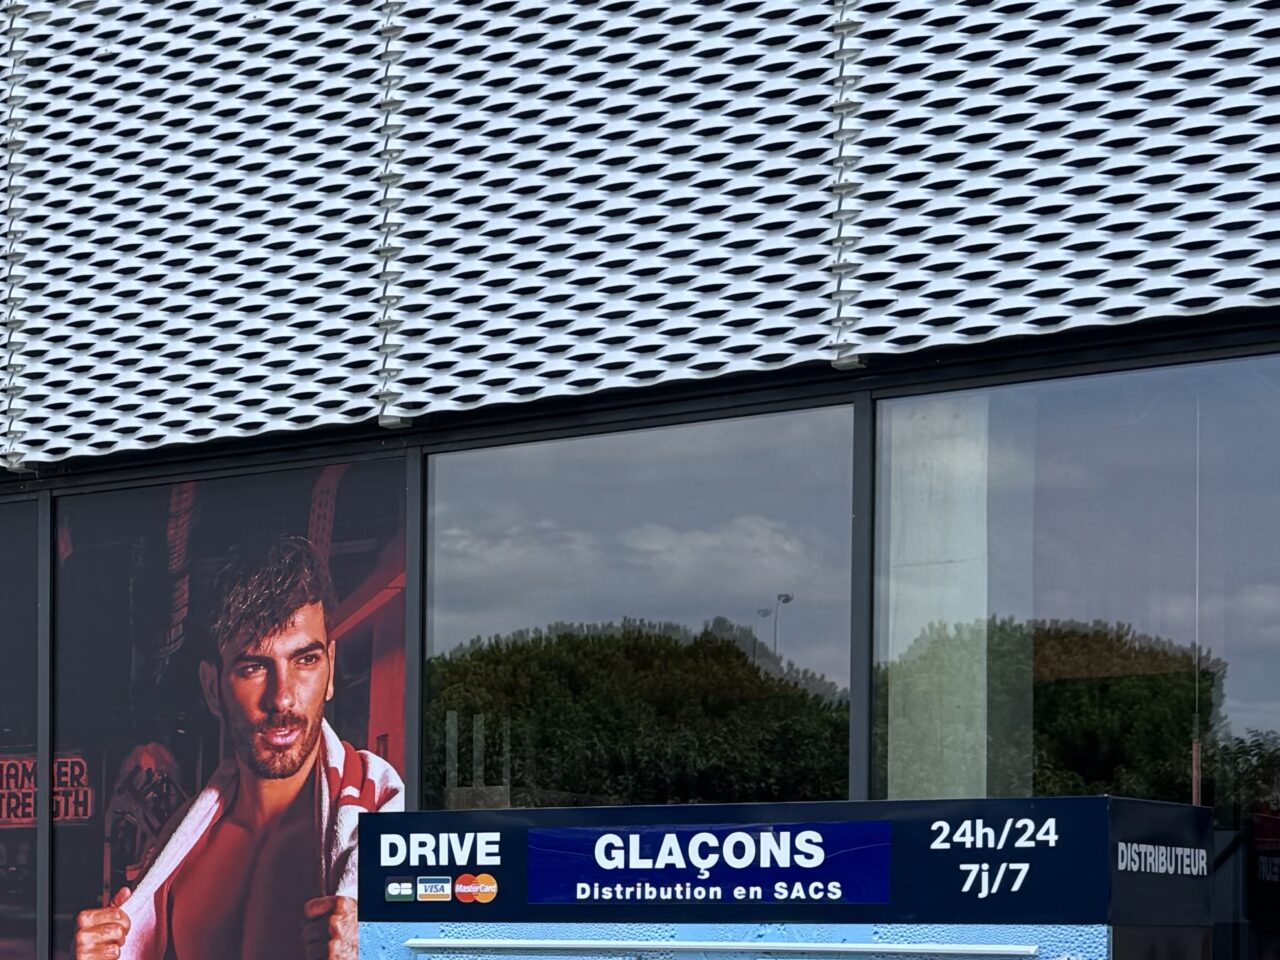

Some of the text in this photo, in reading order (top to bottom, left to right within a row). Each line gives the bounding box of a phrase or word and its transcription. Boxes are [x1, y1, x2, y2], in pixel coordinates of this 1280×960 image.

[380, 832, 501, 867] DRIVE
[930, 818, 1059, 850] 24h/24
[594, 830, 825, 879] GLAÇONS
[1118, 842, 1208, 876] DISTRIBUTEUR
[423, 884, 445, 893] VISA
[455, 883, 497, 893] MasterCard
[576, 881, 842, 900] Distribution en SACS
[959, 863, 1030, 898] 7j/7
